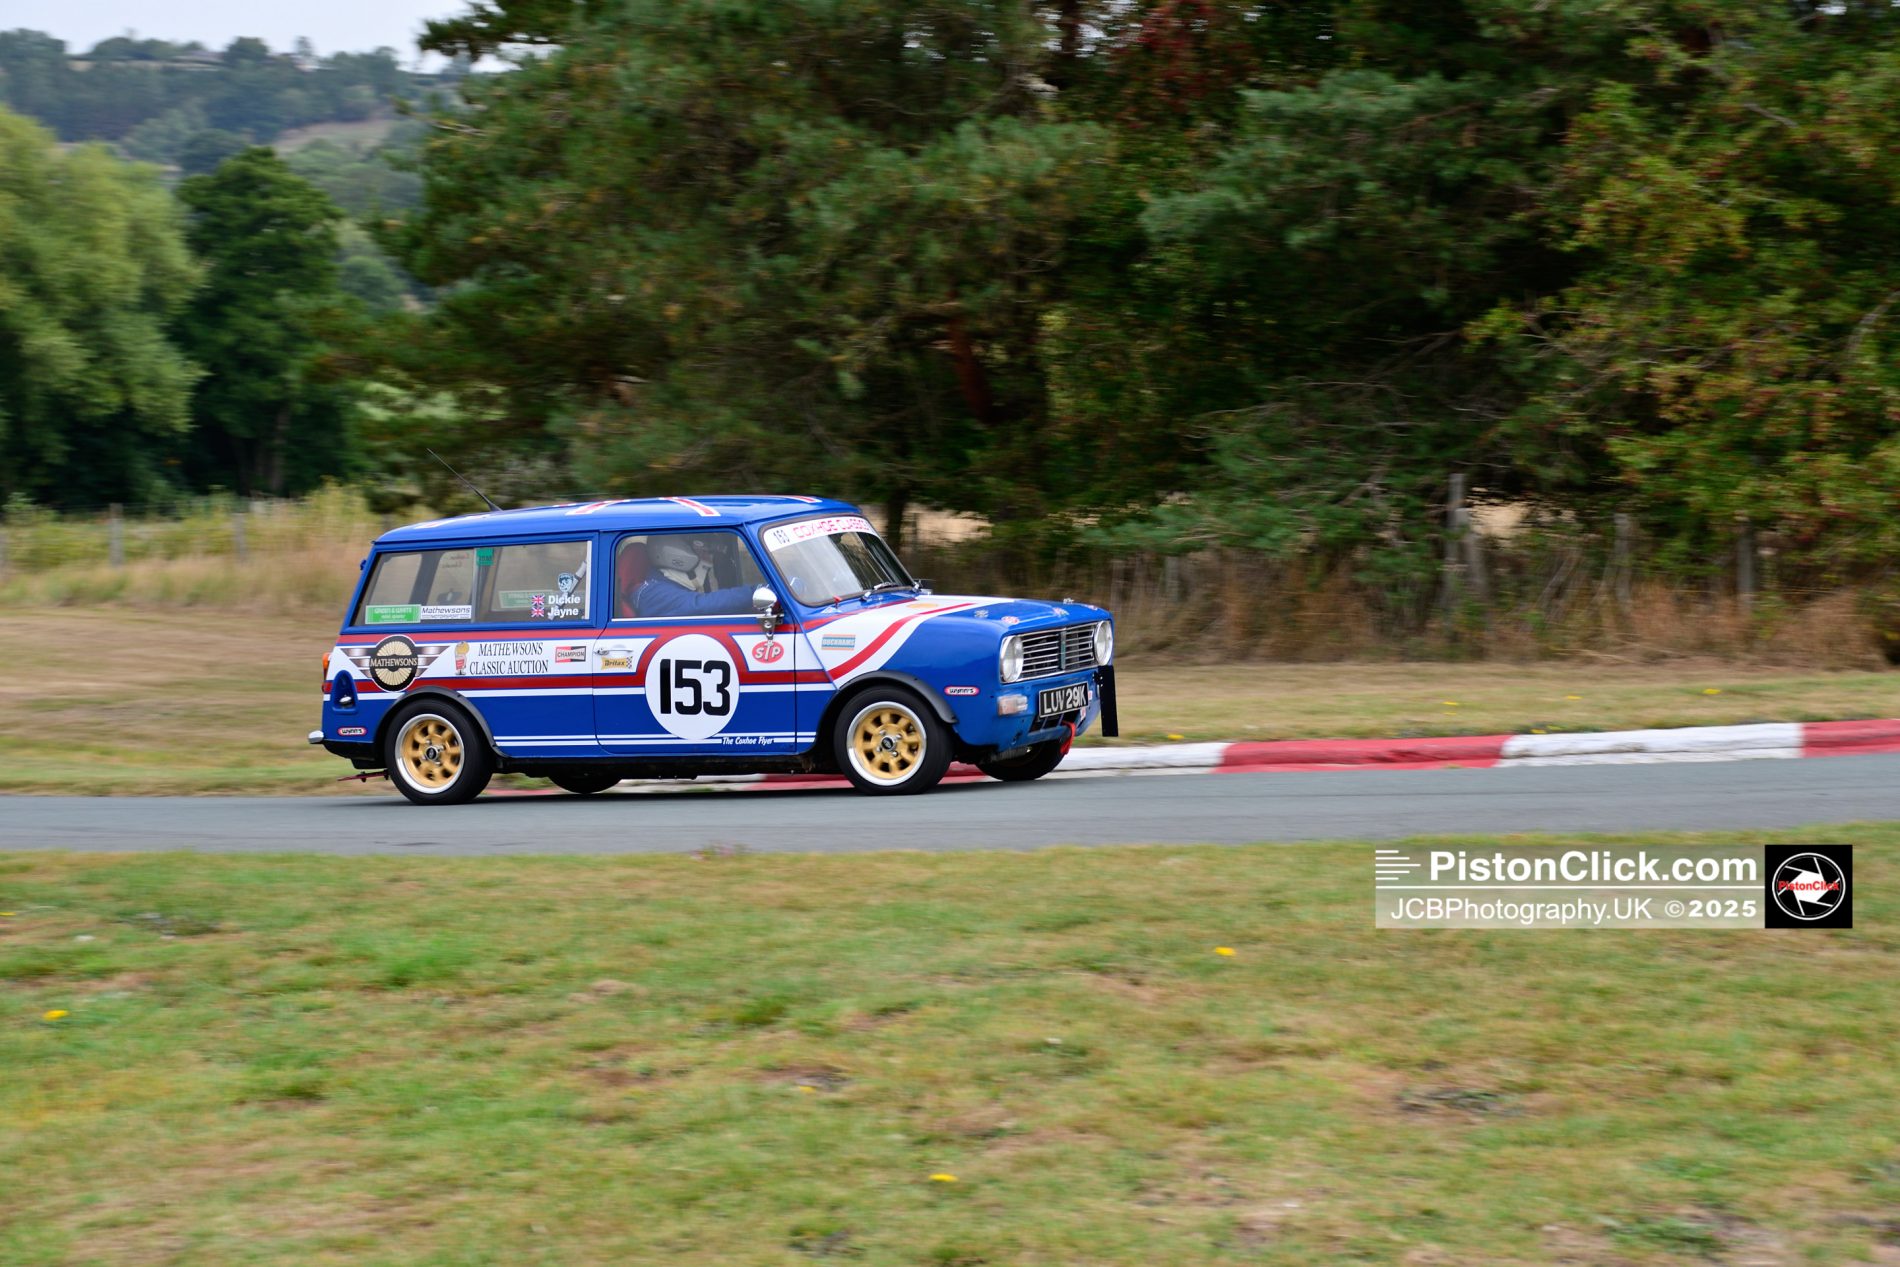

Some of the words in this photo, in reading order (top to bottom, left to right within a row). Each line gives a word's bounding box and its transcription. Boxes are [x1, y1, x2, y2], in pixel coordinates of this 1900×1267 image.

[773, 529, 790, 544] 153
[548, 594, 580, 604] Dickie
[422, 606, 470, 614] Mathewsons
[548, 607, 579, 618] Jayne
[478, 642, 543, 657] MATHEWSONS
[557, 650, 585, 659] CHAMPION
[755, 641, 781, 661] STP
[370, 657, 418, 667] MATHEWSONS
[469, 661, 507, 675] CLASSIC
[507, 660, 549, 674] AUCTION
[604, 659, 625, 667] Britax
[659, 658, 731, 716] 153
[1043, 688, 1065, 714] LUV
[1065, 685, 1087, 709] 291K
[722, 736, 734, 745] The
[735, 736, 757, 745] Coxhoe
[758, 736, 773, 746] Flyer
